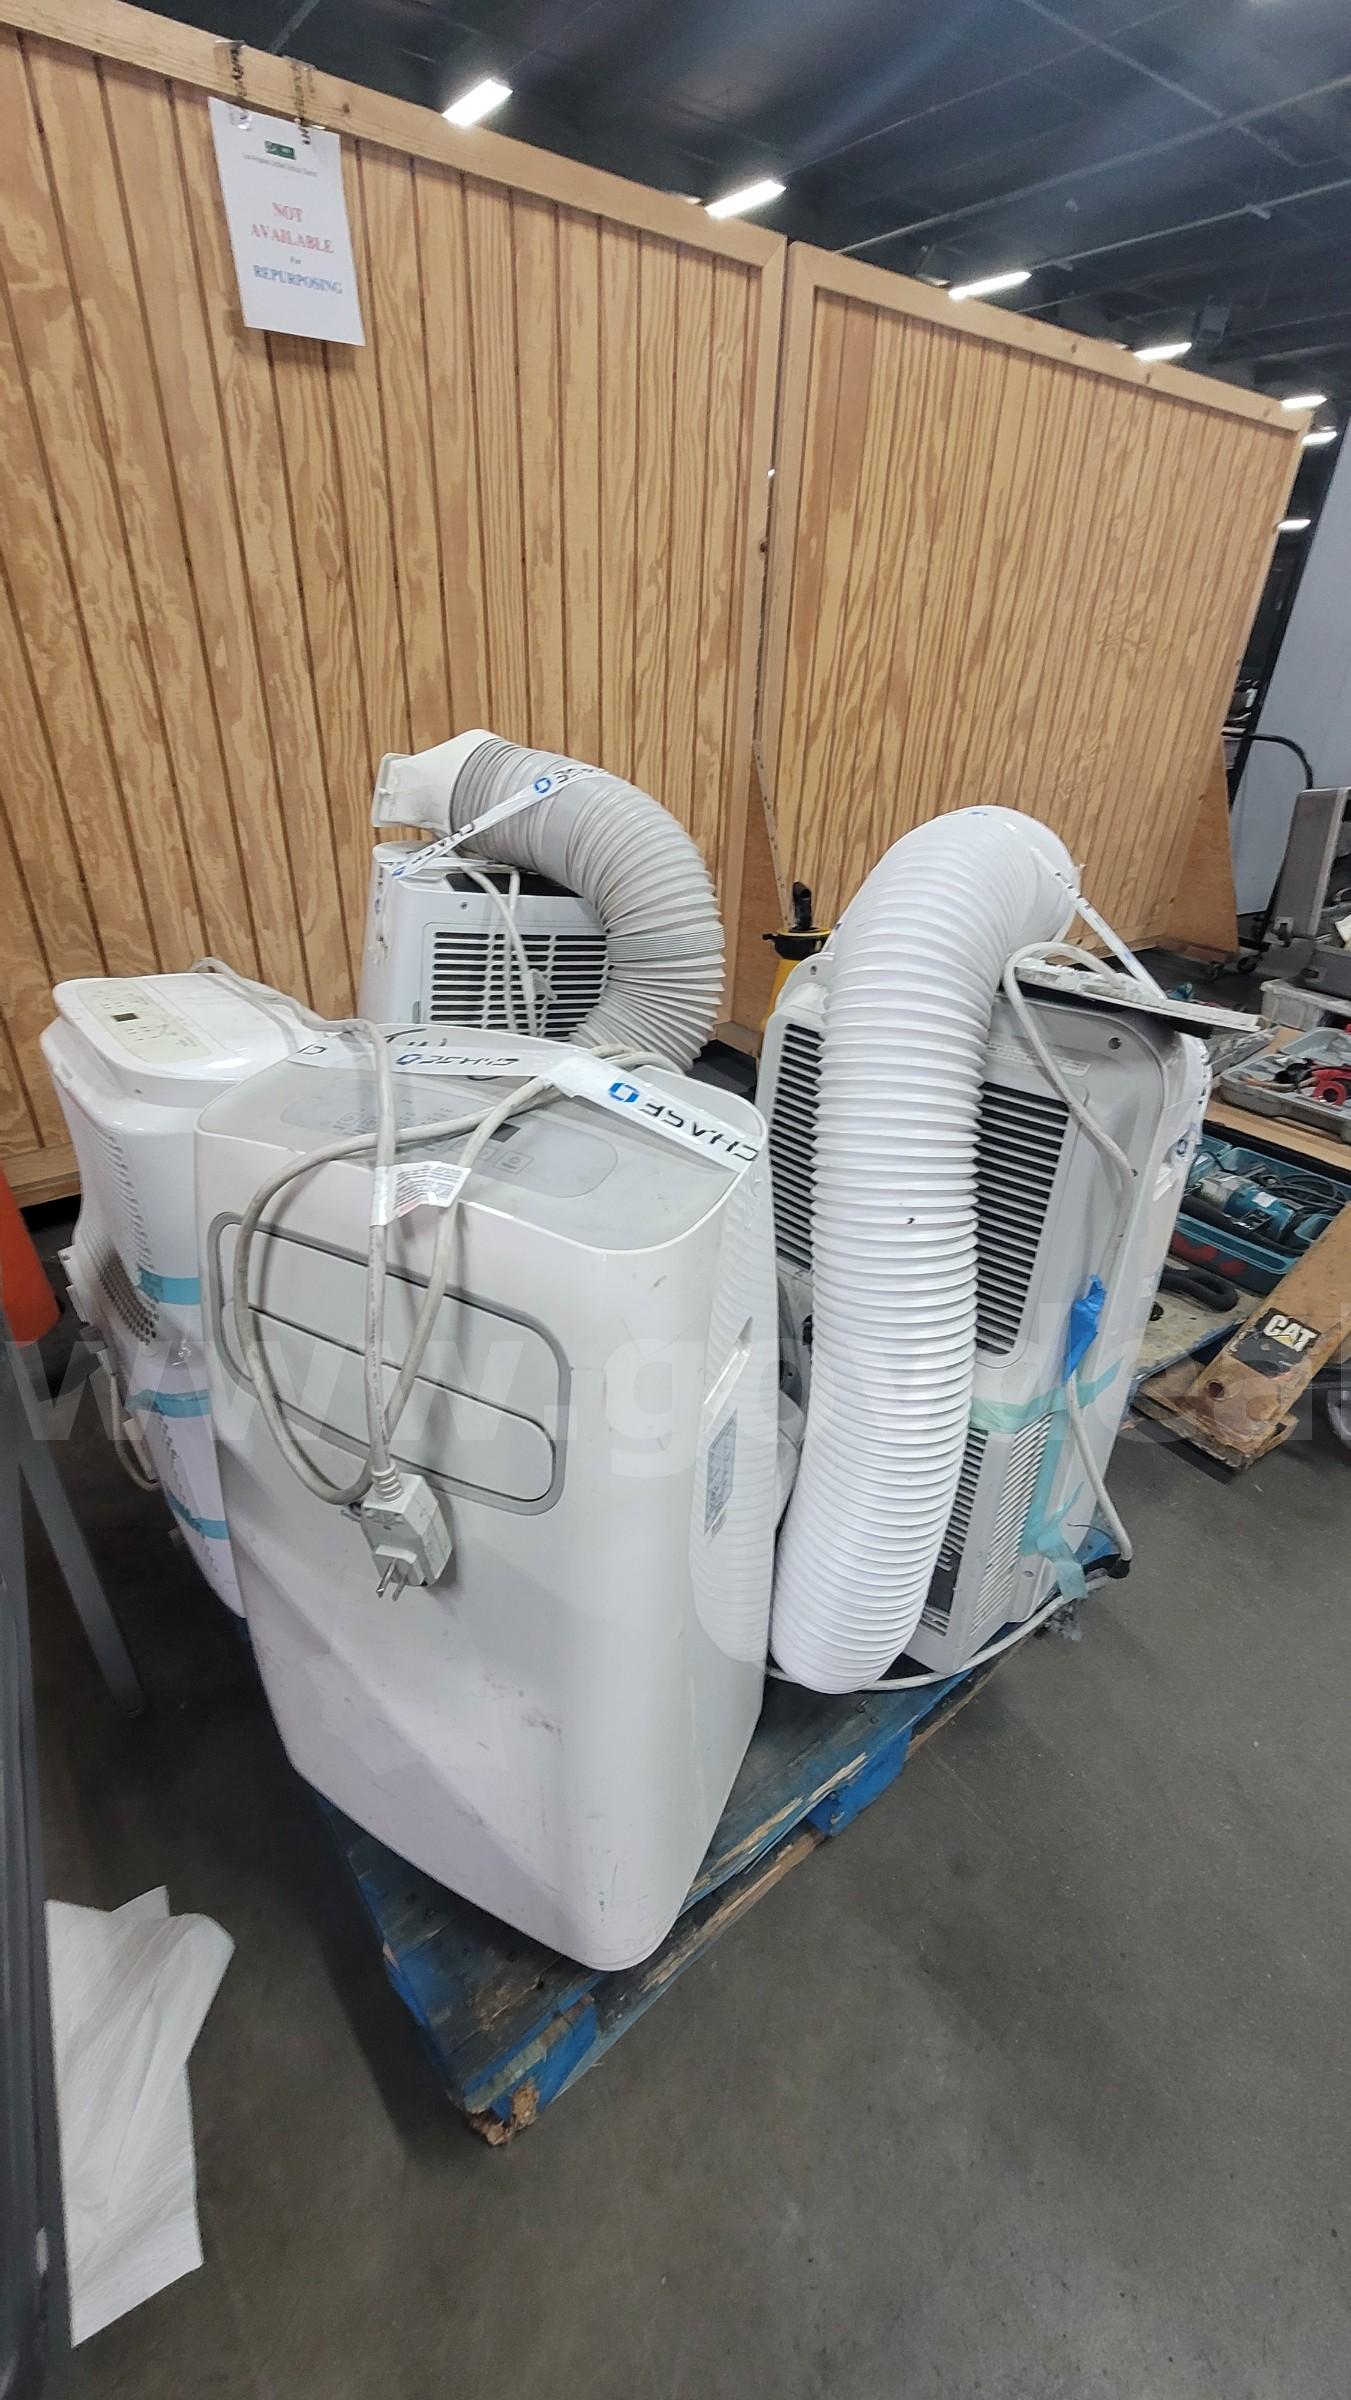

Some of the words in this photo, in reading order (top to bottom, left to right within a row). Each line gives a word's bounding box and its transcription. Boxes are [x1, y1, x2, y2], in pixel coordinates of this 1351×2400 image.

[272, 202, 304, 223] NOT
[251, 224, 334, 254] AVAILABLE
[253, 265, 343, 295] REPURPOSING
[640, 1102, 759, 1162] CHASE
[1263, 1314, 1318, 1353] CAT
